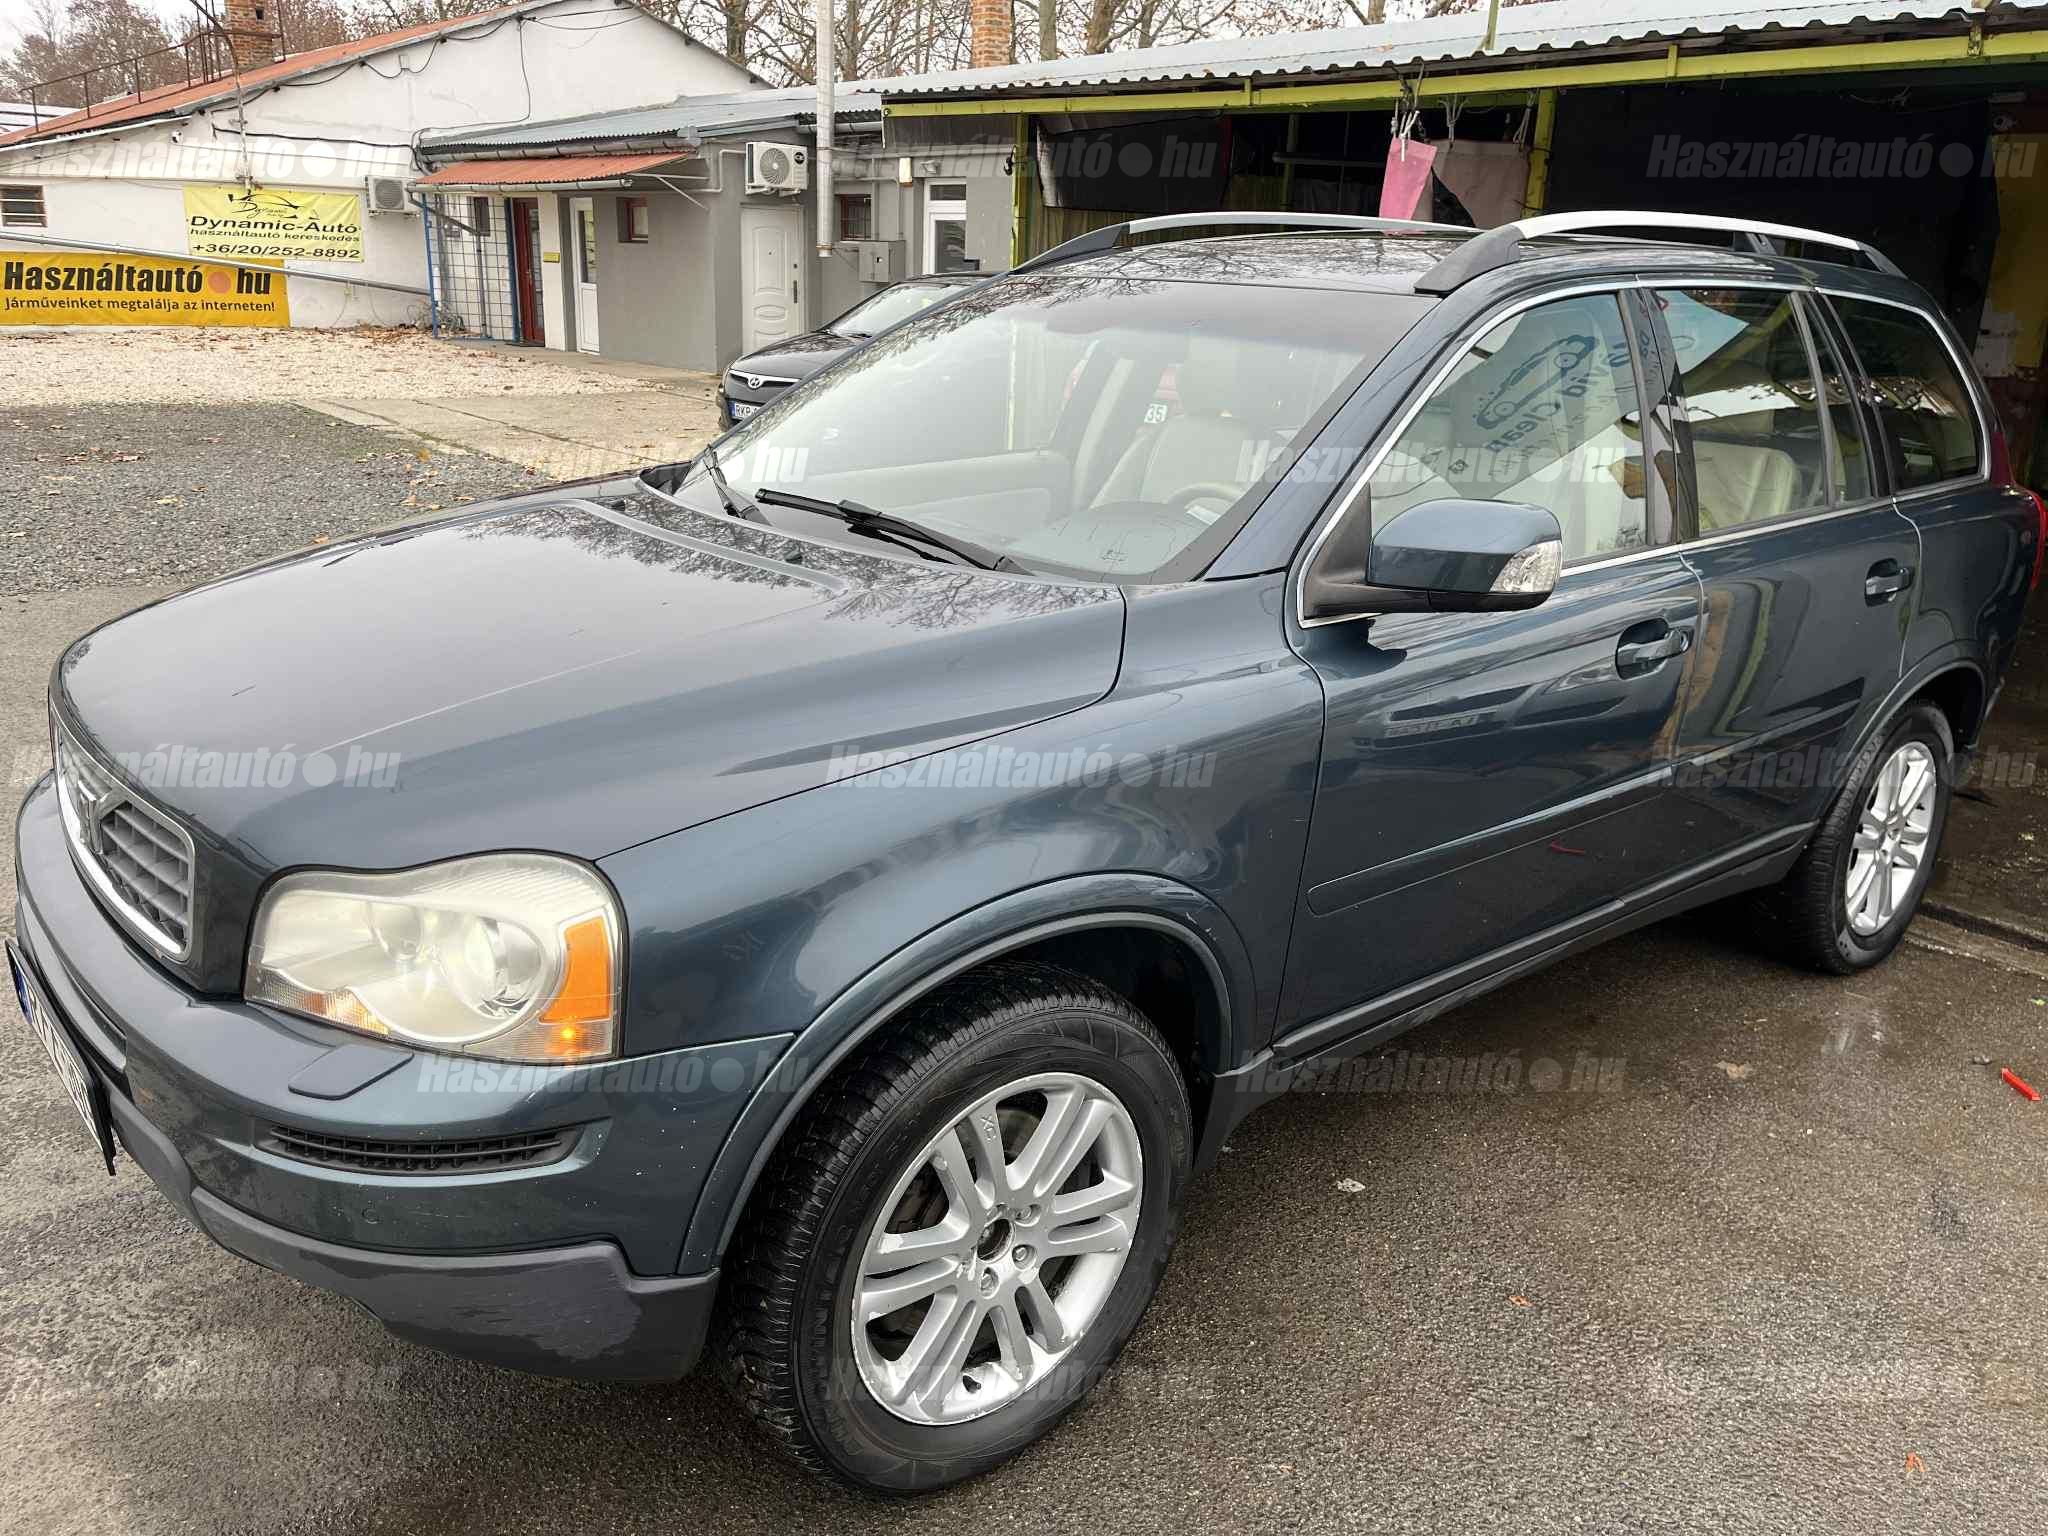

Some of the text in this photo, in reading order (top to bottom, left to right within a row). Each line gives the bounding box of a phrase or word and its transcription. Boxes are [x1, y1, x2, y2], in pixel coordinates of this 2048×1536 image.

[193, 243, 360, 258] +36/20/252-8892
[5, 296, 275, 312] Járműveinket megtalálja az interneten!
